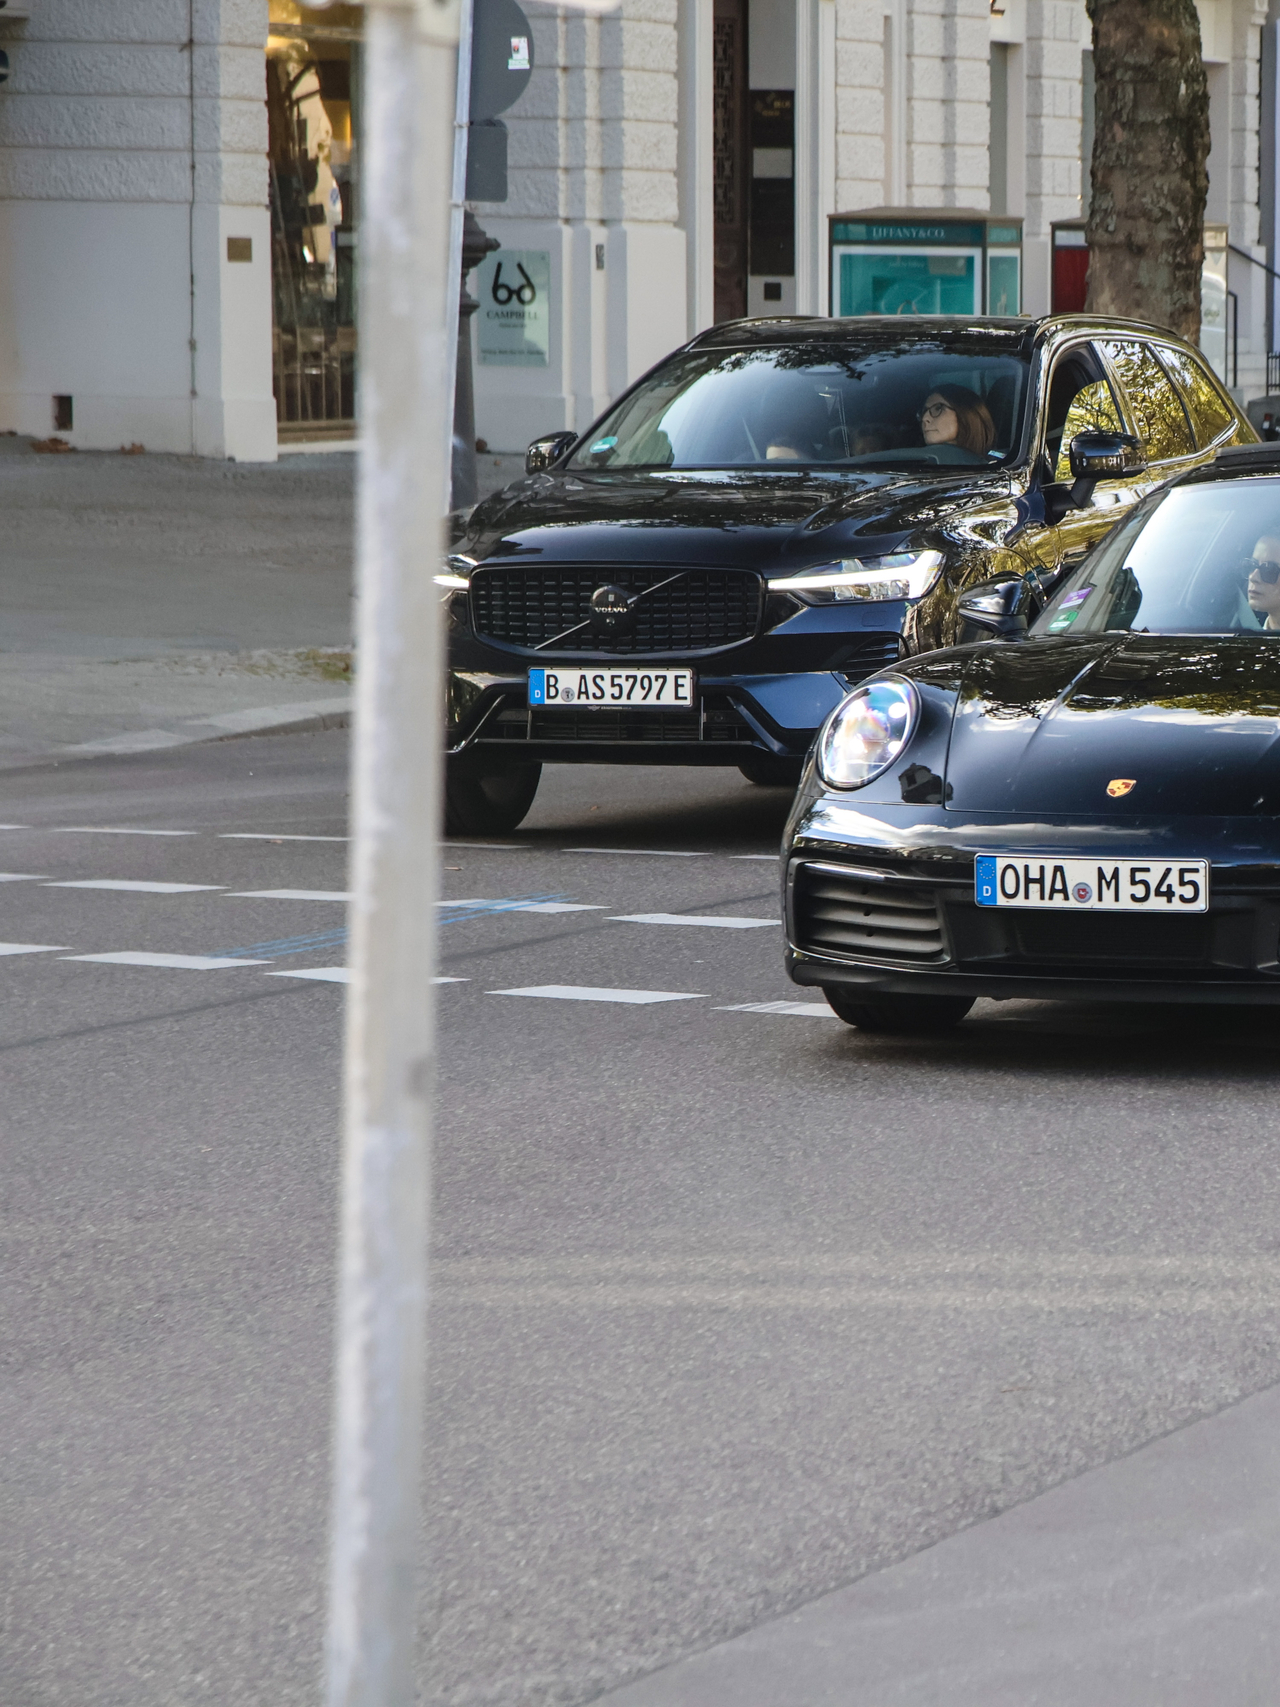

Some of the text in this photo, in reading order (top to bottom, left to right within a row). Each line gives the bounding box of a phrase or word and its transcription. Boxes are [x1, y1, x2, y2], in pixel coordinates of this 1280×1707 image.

[486, 309, 540, 321] CAMPBELL
[594, 606, 628, 614] VOLVO
[546, 674, 559, 700] B
[577, 674, 605, 700] AS
[1000, 863, 1200, 904] OHA M 545
[982, 885, 992, 897] D
